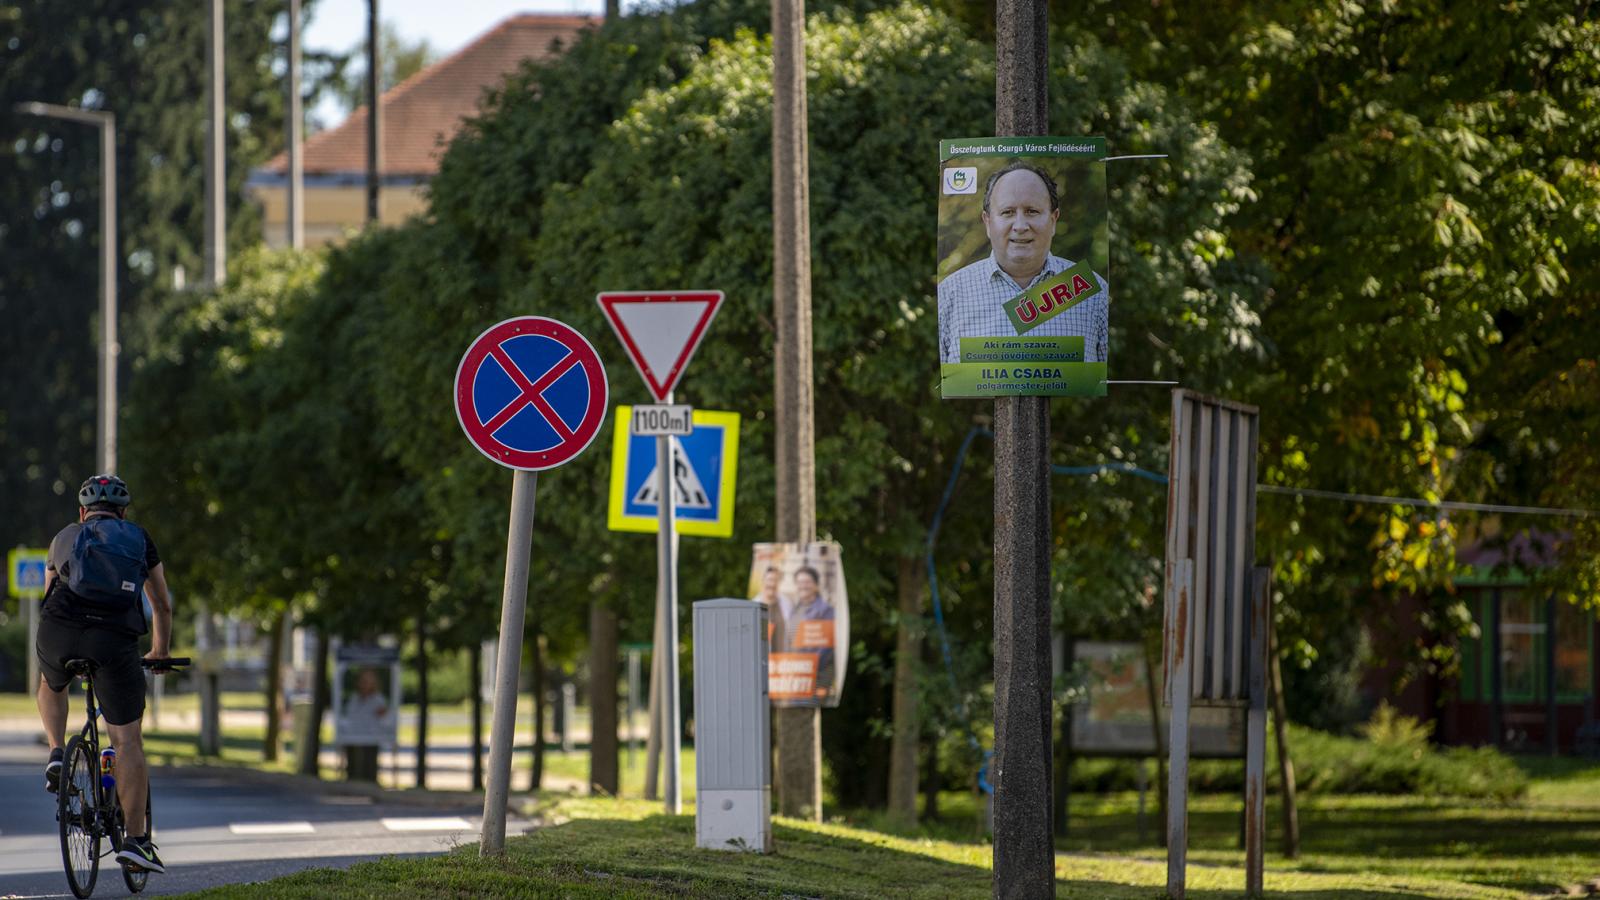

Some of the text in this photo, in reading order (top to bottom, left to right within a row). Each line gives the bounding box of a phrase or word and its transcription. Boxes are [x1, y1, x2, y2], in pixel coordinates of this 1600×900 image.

[950, 144, 996, 155] Összefogtunk
[997, 144, 1024, 154] Csurgó
[1025, 143, 1047, 152] Város
[1014, 273, 1093, 324] ÚJRA
[983, 341, 1060, 349] Aki rám szavaz,
[966, 352, 998, 361] Csurgó
[1043, 352, 1079, 360] szavaz!
[982, 368, 1062, 379] ILIA CSABA
[976, 382, 1067, 391] polgármester-jelölt
[641, 409, 683, 431] 100m
